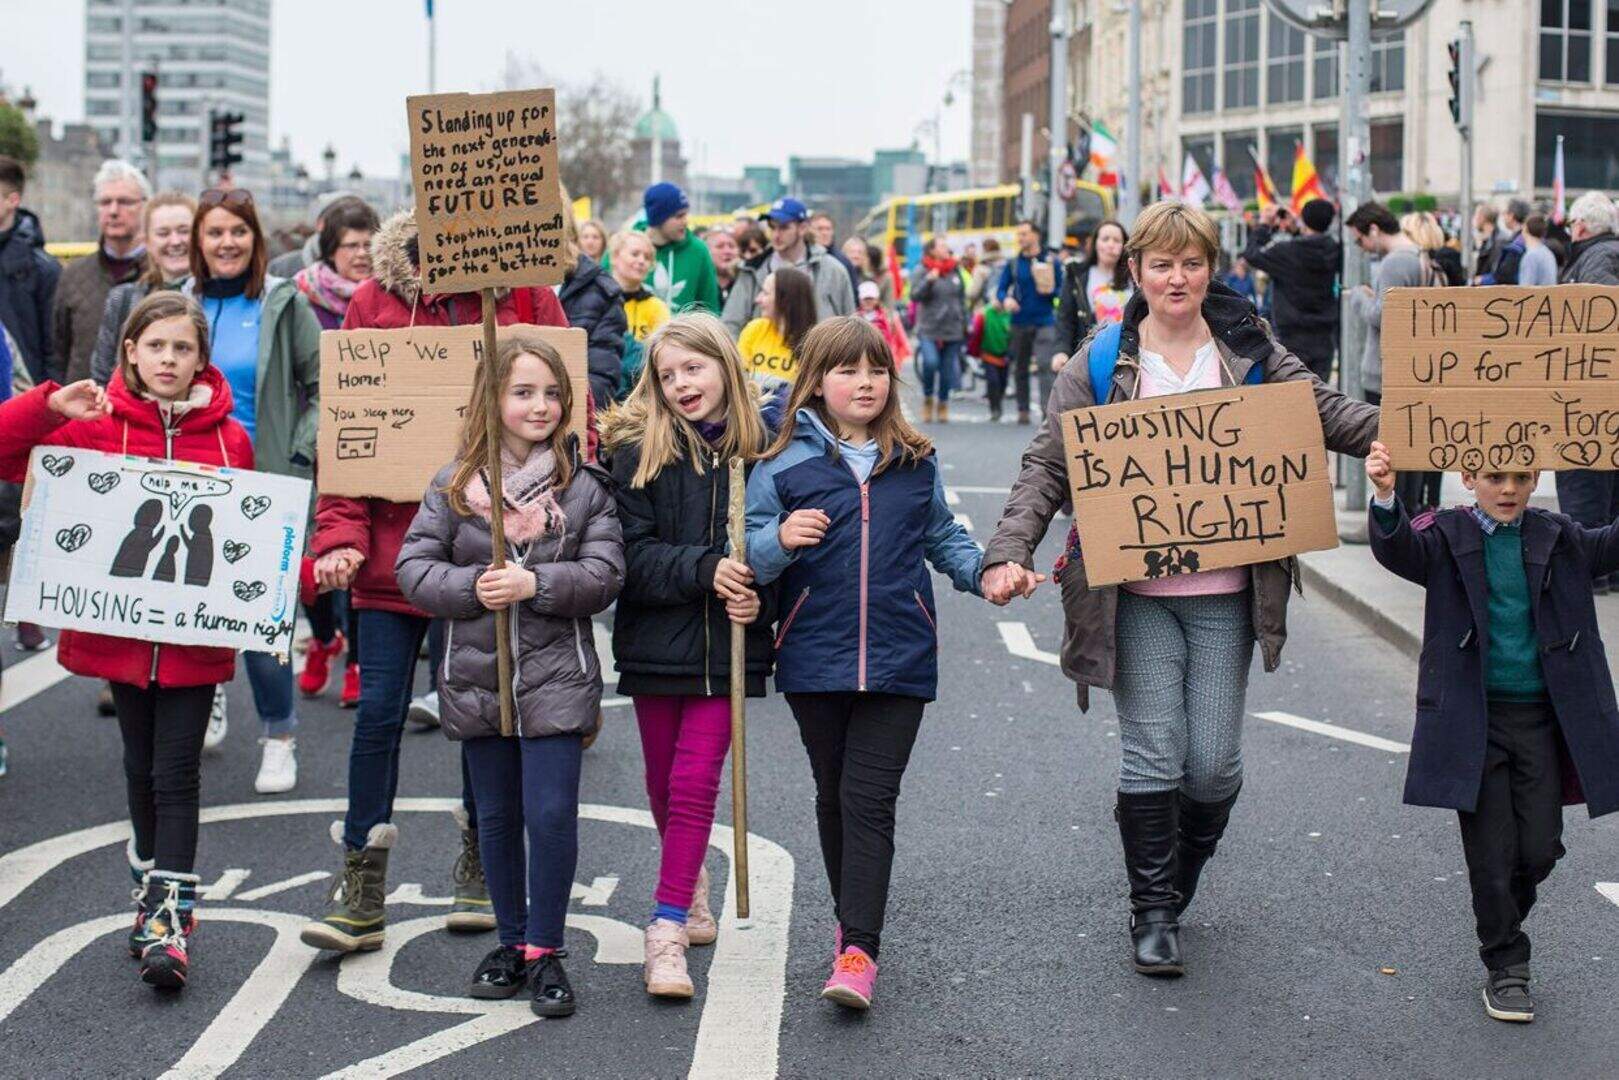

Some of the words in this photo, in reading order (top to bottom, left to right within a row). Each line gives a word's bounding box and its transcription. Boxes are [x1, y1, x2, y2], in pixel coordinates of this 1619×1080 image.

[421, 109, 493, 138] Standing
[497, 109, 515, 131] up
[522, 105, 549, 129] for
[423, 143, 445, 158] the
[452, 135, 486, 155] next
[422, 163, 443, 175] on
[450, 161, 467, 178] of
[476, 158, 501, 172] us,
[503, 150, 541, 167] who
[424, 175, 467, 191] need
[472, 175, 494, 186] an
[500, 166, 543, 187] equal
[427, 183, 539, 215] FUTURE
[504, 220, 532, 236] and
[427, 252, 444, 264] be
[452, 242, 524, 262] changing
[527, 236, 560, 249] lives
[428, 265, 456, 284] for
[462, 261, 489, 274] the
[500, 254, 557, 272] better.
[1482, 295, 1619, 339] STAND
[338, 338, 391, 367] Help
[414, 341, 448, 360] We
[1474, 350, 1522, 382] for
[1535, 343, 1616, 381] THE
[338, 372, 386, 390] Home!
[328, 405, 356, 422] You
[1396, 401, 1491, 448] That
[1119, 455, 1154, 487] A
[39, 581, 142, 624] HOUSING
[175, 612, 187, 627] a
[194, 602, 247, 632] human
[253, 618, 293, 645] right
